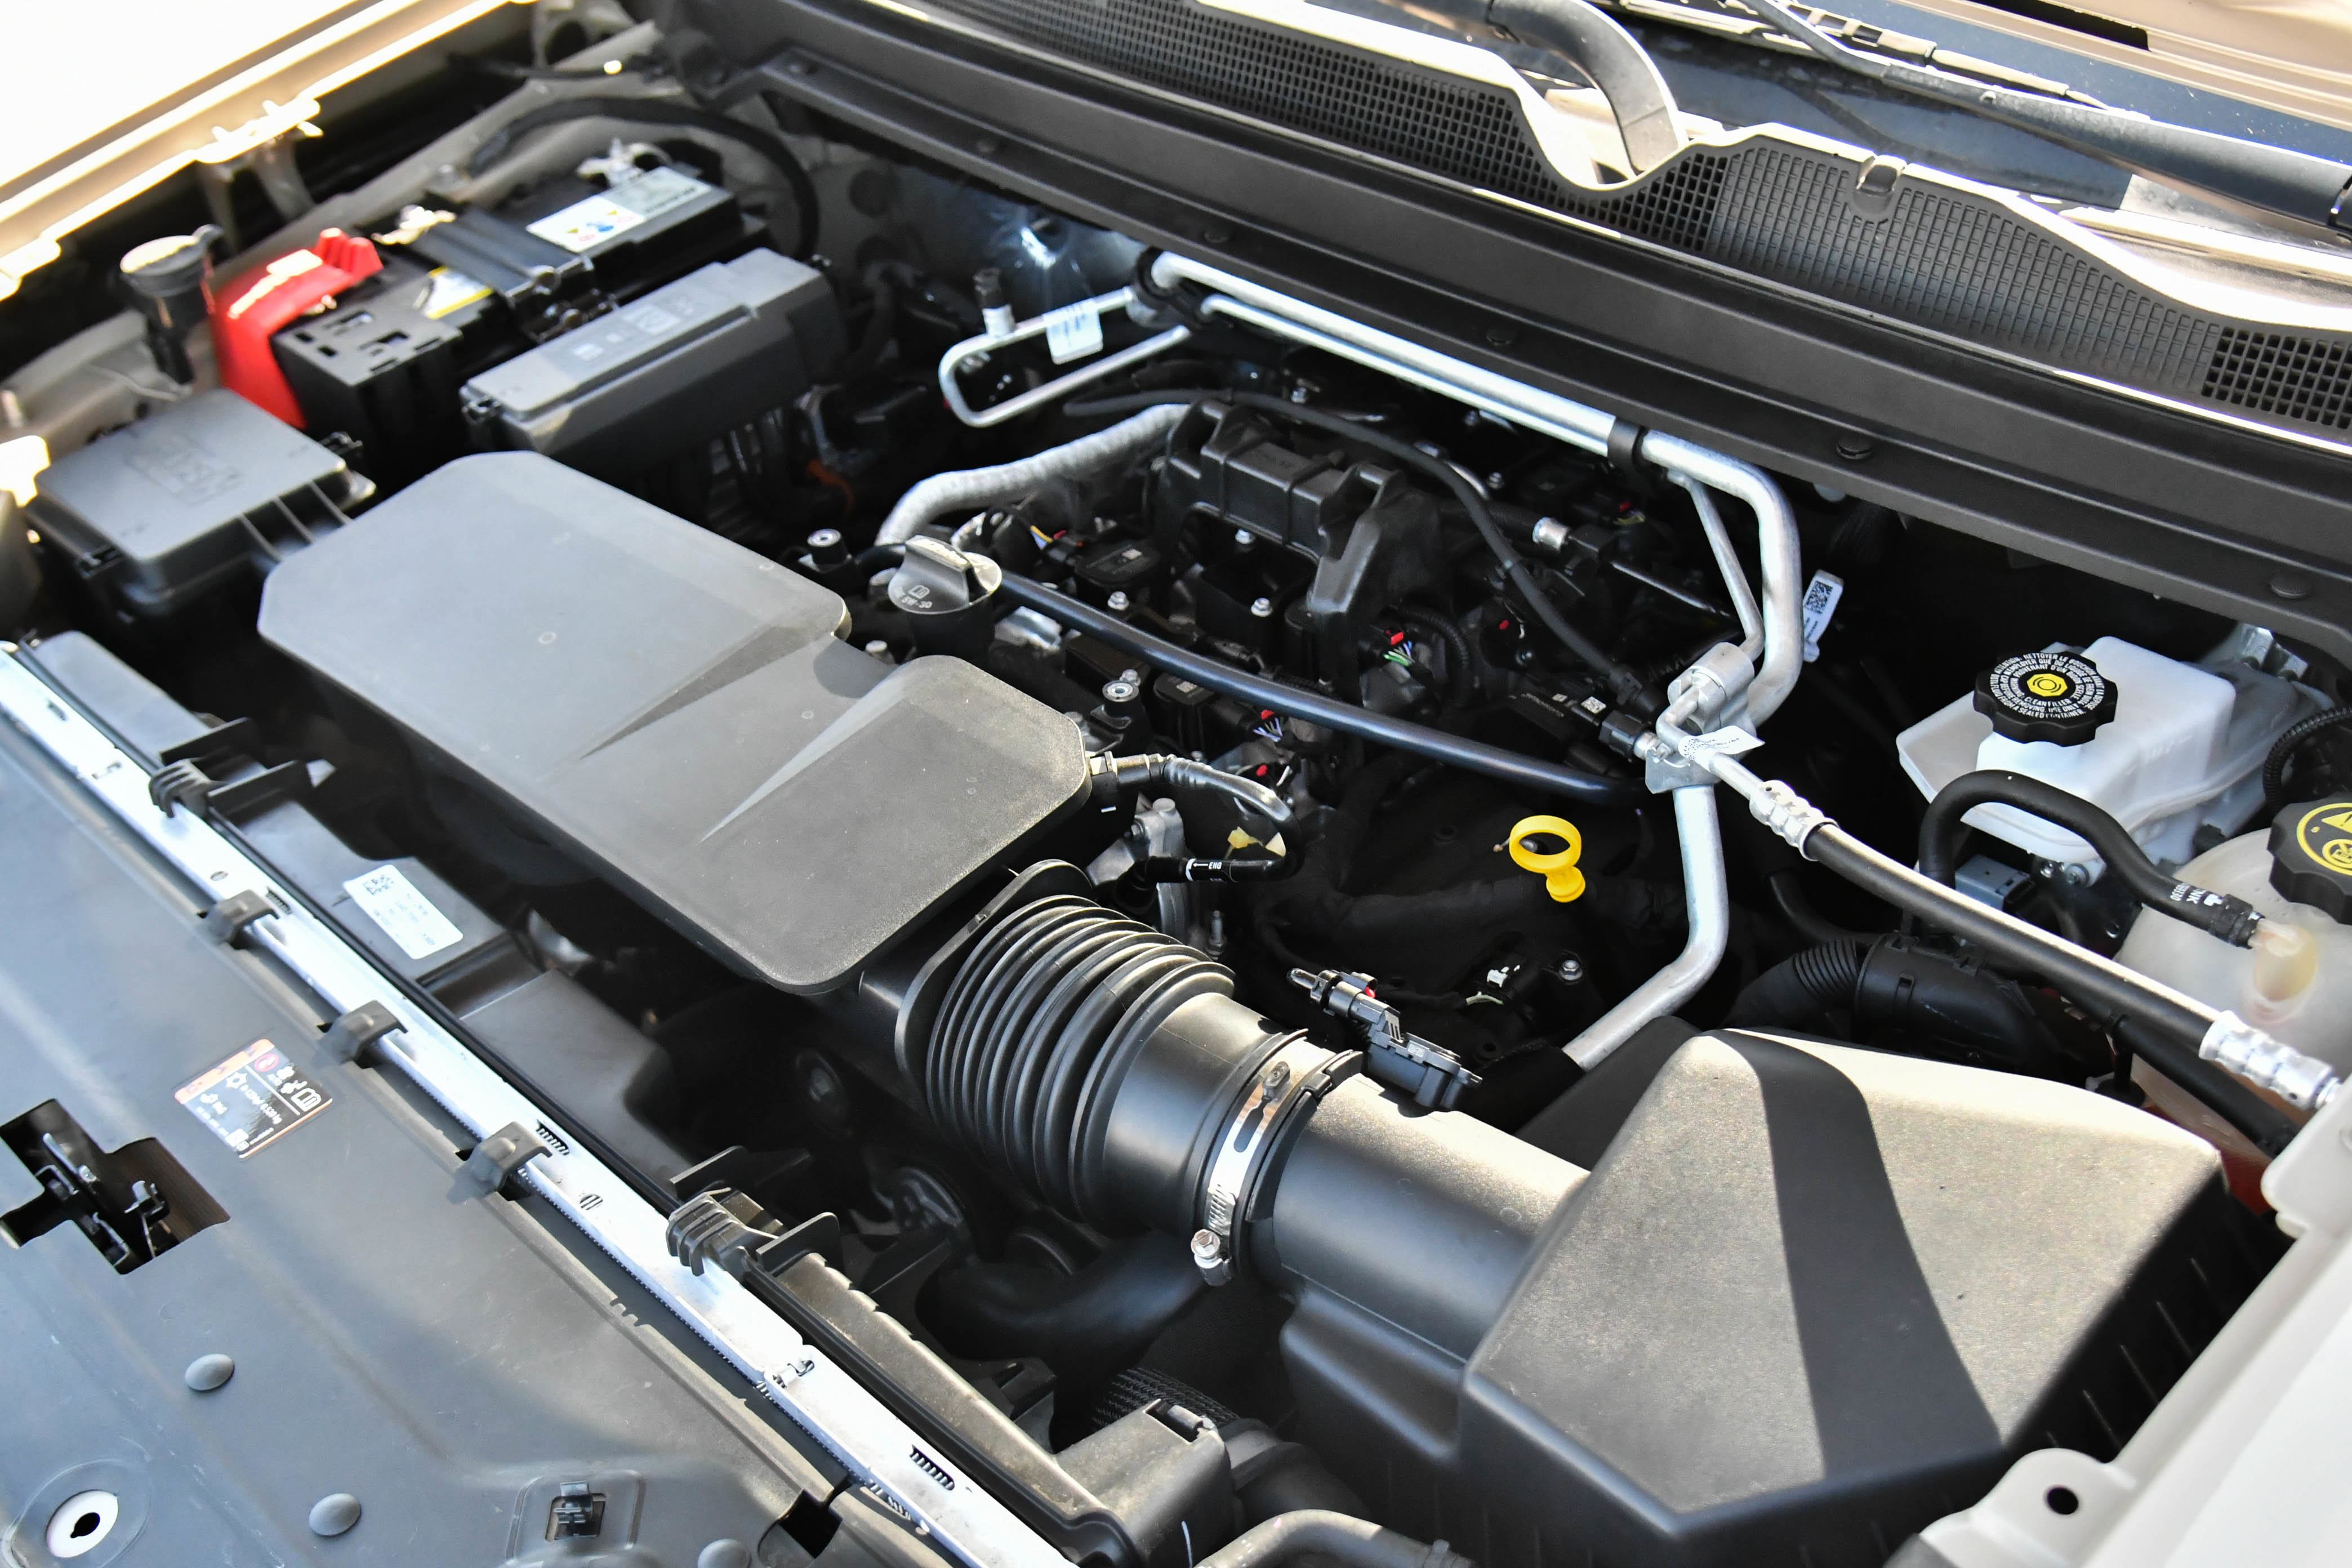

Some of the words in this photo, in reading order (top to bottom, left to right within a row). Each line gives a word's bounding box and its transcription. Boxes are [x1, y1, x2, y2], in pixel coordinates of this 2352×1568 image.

[2013, 663, 2048, 678] PROVENANT
[2064, 663, 2087, 677] LIQUIDE
[2086, 683, 2095, 696] FREIN
[2069, 659, 2097, 675] BOUCHON
[2091, 675, 2105, 689] AVANT
[1991, 684, 2003, 697] FLUID
[1998, 696, 2016, 708] FROM
[2018, 707, 2044, 719] SEALED
[2001, 683, 2015, 700] BEFORE
[2062, 703, 2079, 712] ONLY
[2024, 696, 2047, 707] CLEAN
[2047, 698, 2072, 707] FILLER
